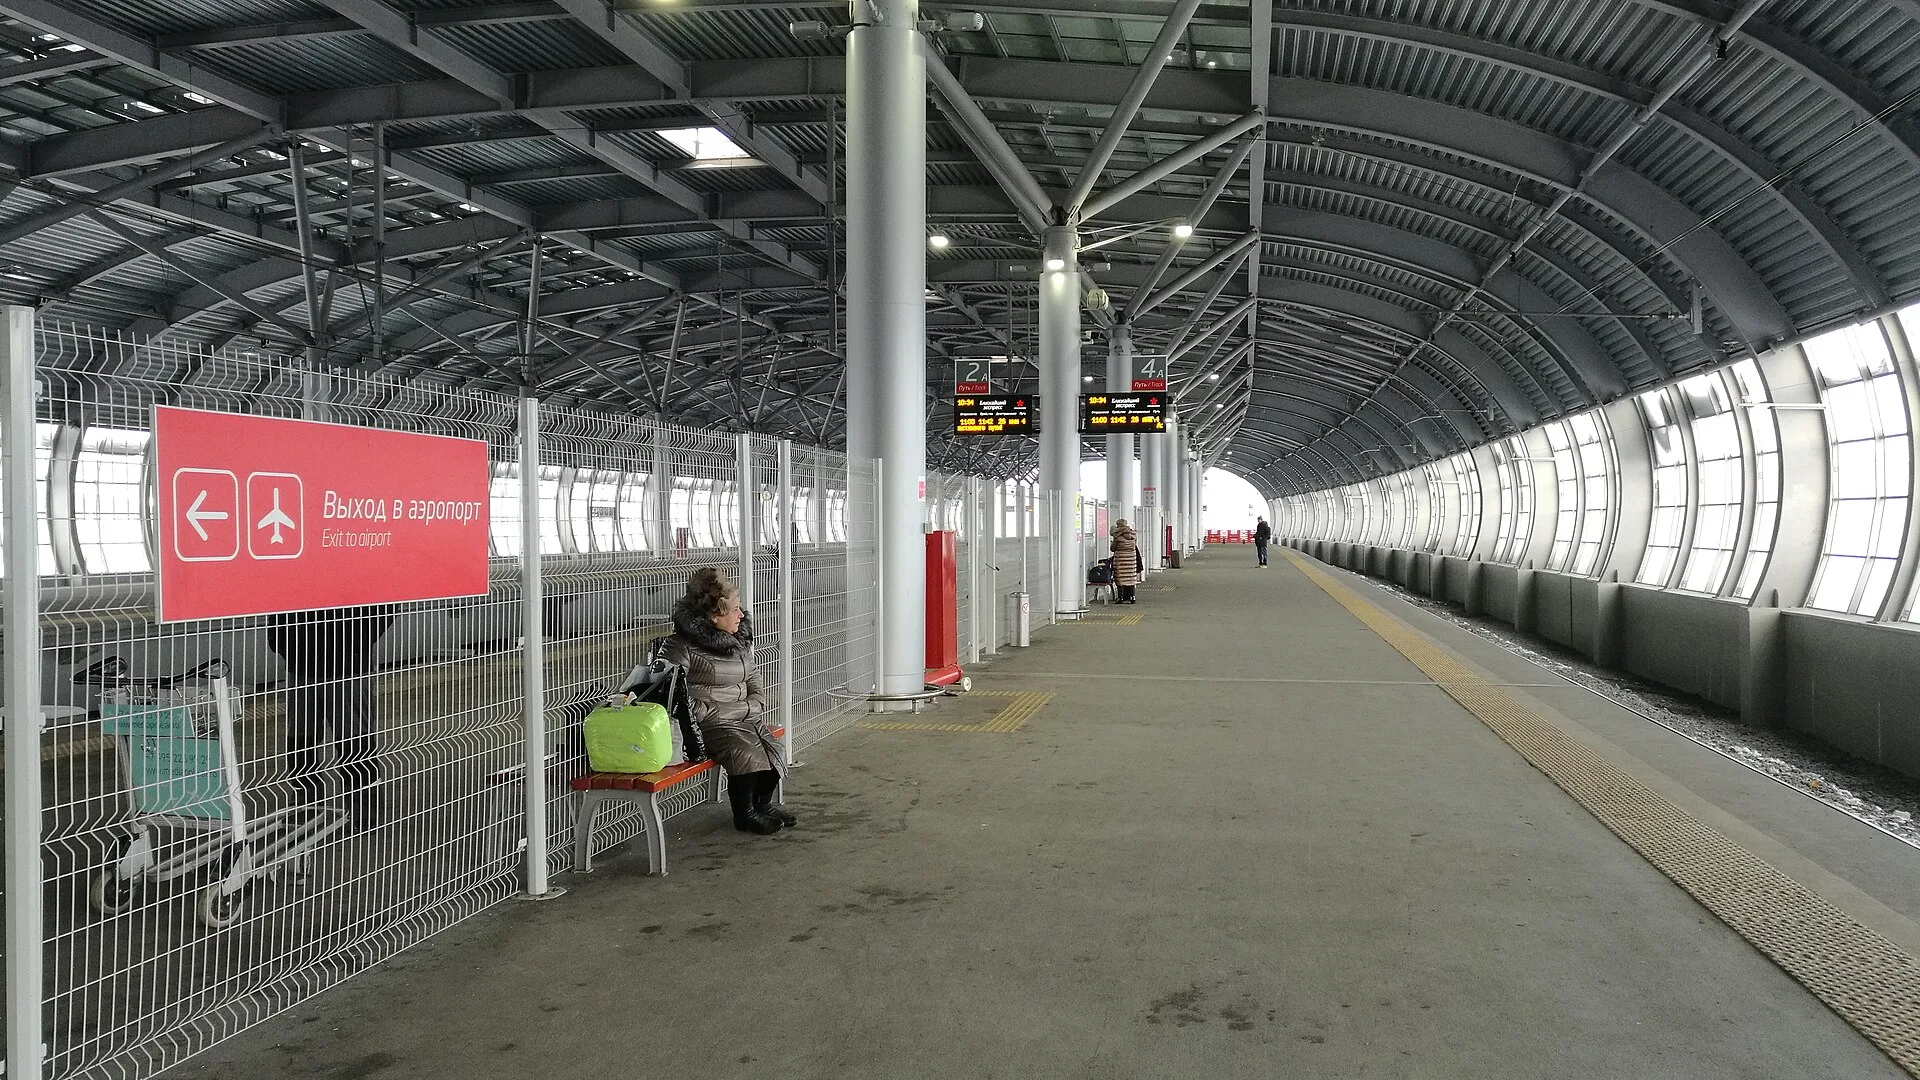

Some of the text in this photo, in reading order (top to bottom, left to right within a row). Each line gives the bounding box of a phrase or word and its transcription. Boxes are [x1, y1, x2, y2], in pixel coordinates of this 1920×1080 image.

[1091, 416, 1108, 424] 11:00
[1110, 416, 1127, 424] 11:42
[323, 490, 482, 526] Выход в аэропорт
[322, 528, 392, 550] Exit to airport
